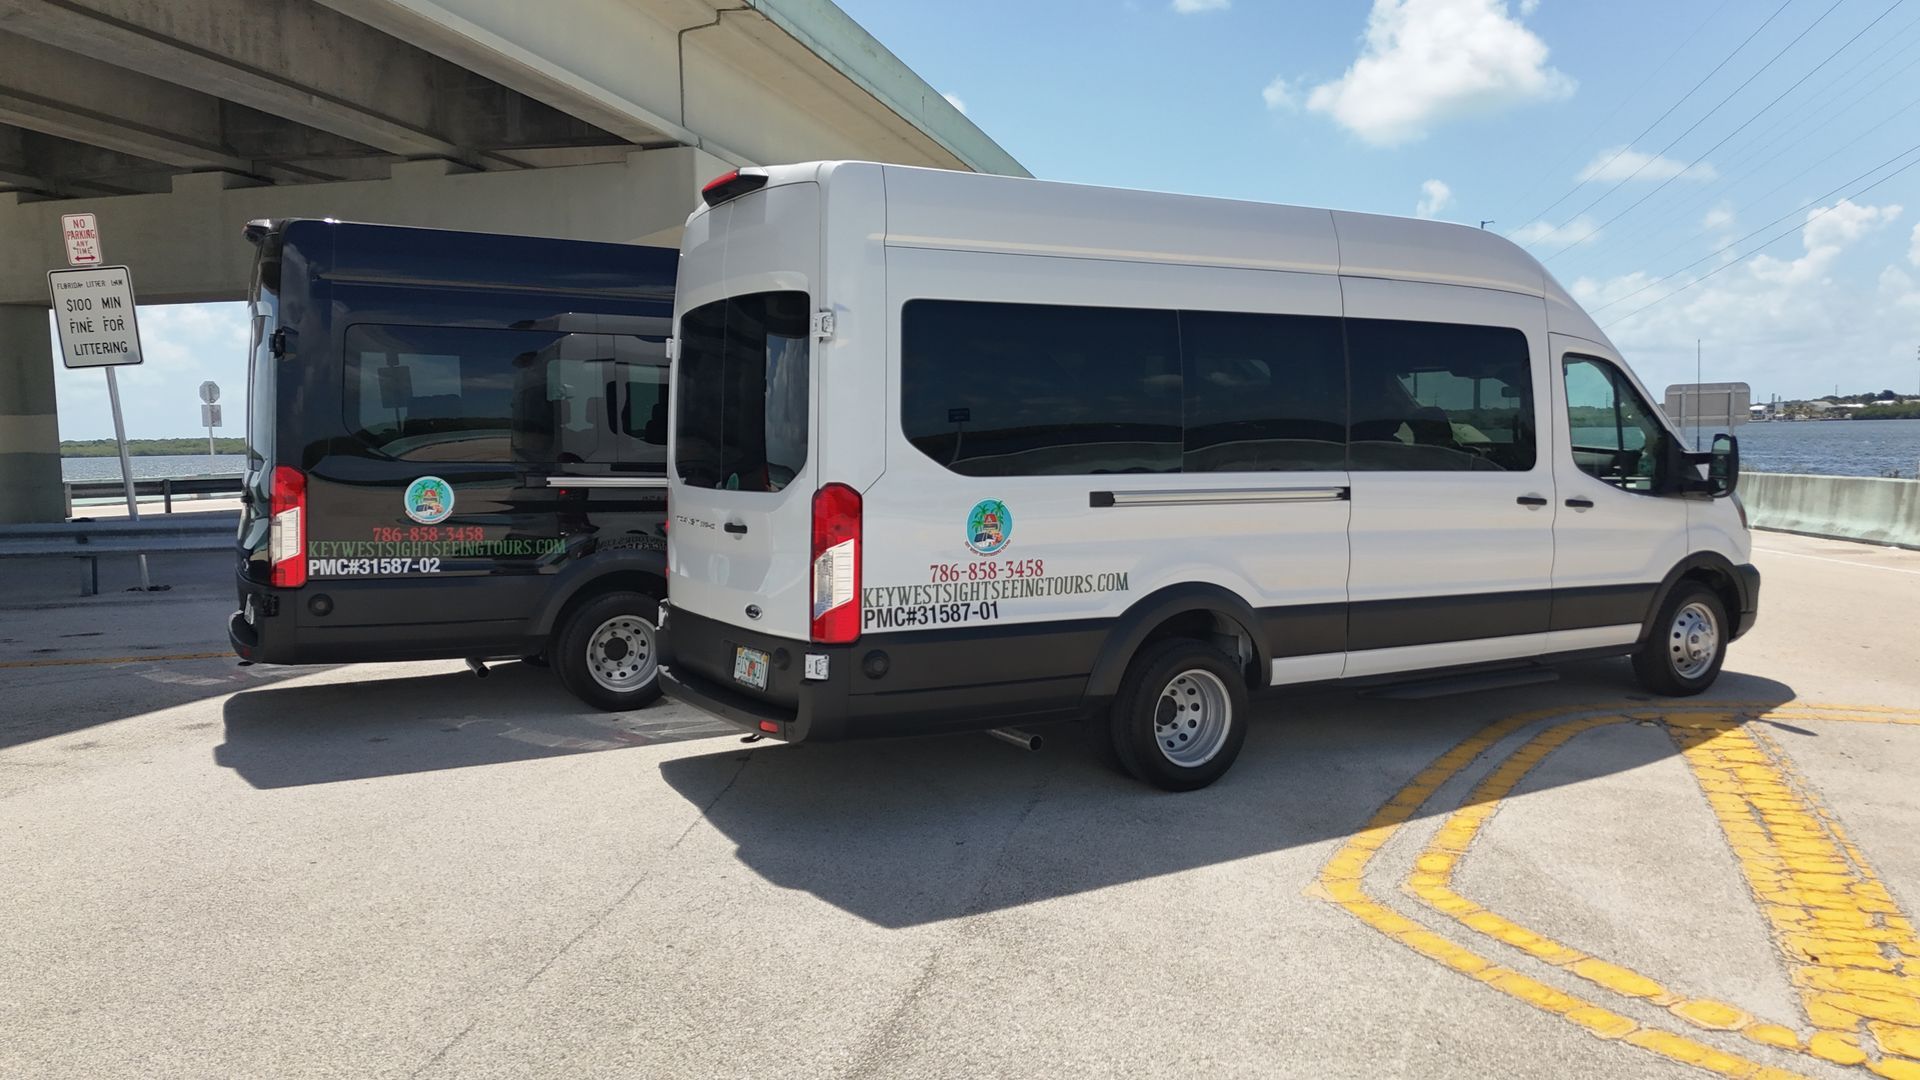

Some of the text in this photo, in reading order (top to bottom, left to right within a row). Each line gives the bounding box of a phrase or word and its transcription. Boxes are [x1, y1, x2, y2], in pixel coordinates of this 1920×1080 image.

[73, 219, 85, 228] NO
[66, 229, 96, 240] PARKING
[57, 282, 82, 290] FLORIDA
[86, 280, 106, 288] LITTER
[66, 296, 122, 312] $100 MIN
[69, 318, 125, 334] FINE FOR
[74, 341, 128, 356] LITTERING
[372, 527, 484, 543] 786-858-3458
[308, 539, 567, 558] KEYWESTSIGHTSEEINGTOURS.COM
[308, 558, 440, 576] PMC#31587-02
[930, 559, 1044, 583] 786-858-3458
[863, 572, 1129, 608] KEYWESTSIGHTSEEINGTOURS.COM
[864, 601, 999, 629] PMC#31587-01
